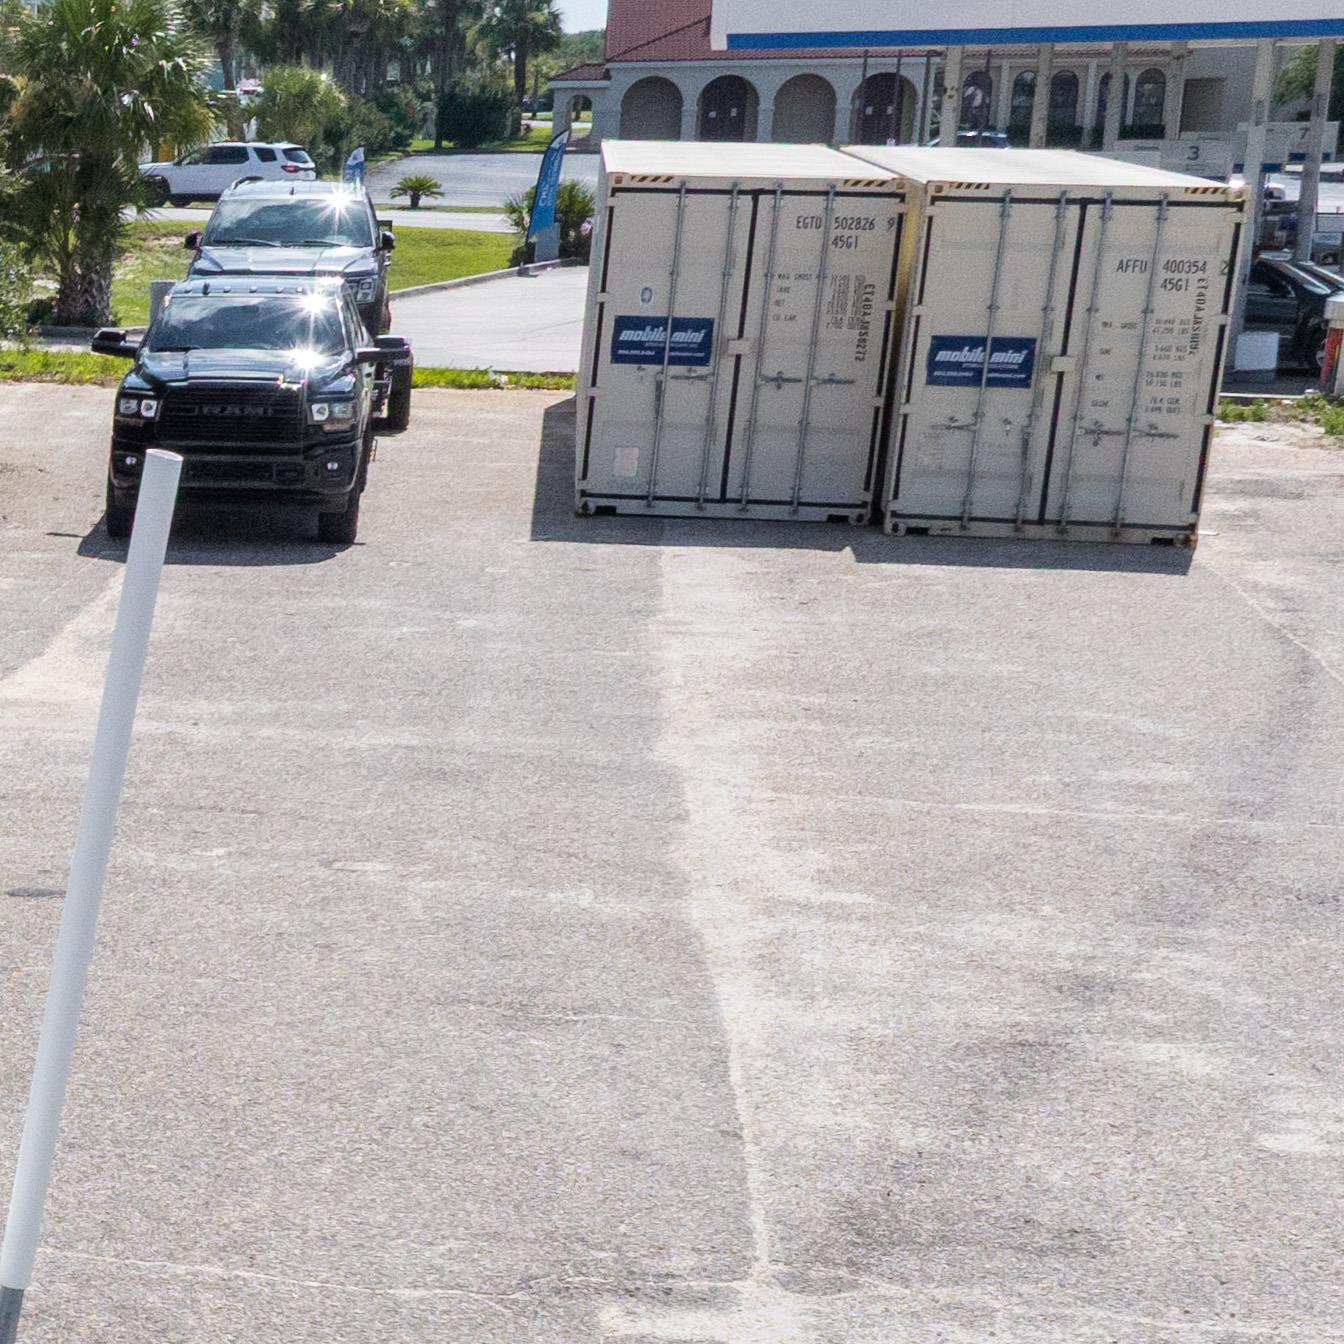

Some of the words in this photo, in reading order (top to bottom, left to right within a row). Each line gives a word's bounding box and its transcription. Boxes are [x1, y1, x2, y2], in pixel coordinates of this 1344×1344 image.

[1187, 145, 1200, 160] 3
[795, 215, 822, 230] EGTU
[833, 216, 876, 231] 502826
[887, 217, 896, 231] 9
[1116, 258, 1148, 274] AFFU
[1162, 259, 1207, 275] 400354
[619, 325, 668, 342] mobile
[671, 328, 706, 343] mini
[934, 346, 986, 362] mobile
[989, 349, 1028, 363] mini
